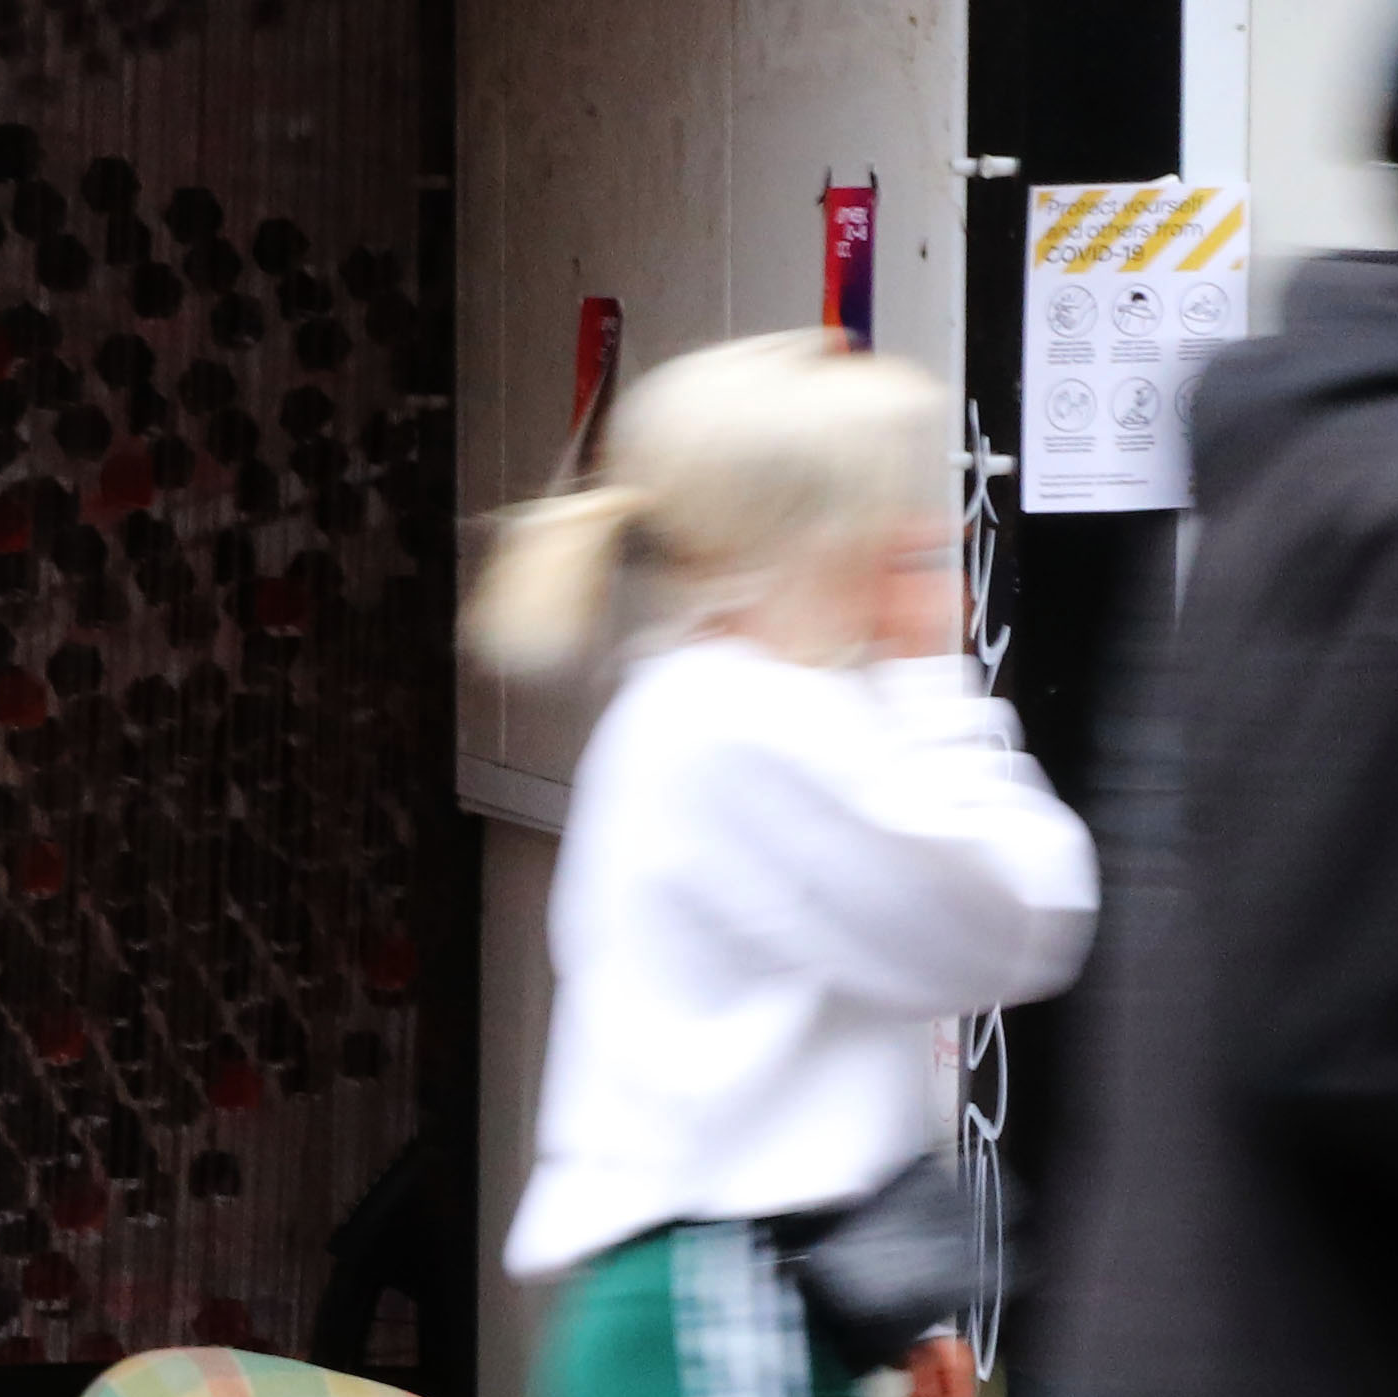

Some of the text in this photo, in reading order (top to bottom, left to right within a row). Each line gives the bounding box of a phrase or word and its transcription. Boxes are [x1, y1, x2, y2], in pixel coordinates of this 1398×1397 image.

[1047, 194, 1204, 217] Protect yourself
[1045, 223, 1084, 241] and
[1087, 222, 1151, 240] others
[1045, 244, 1145, 263] COVID-19
